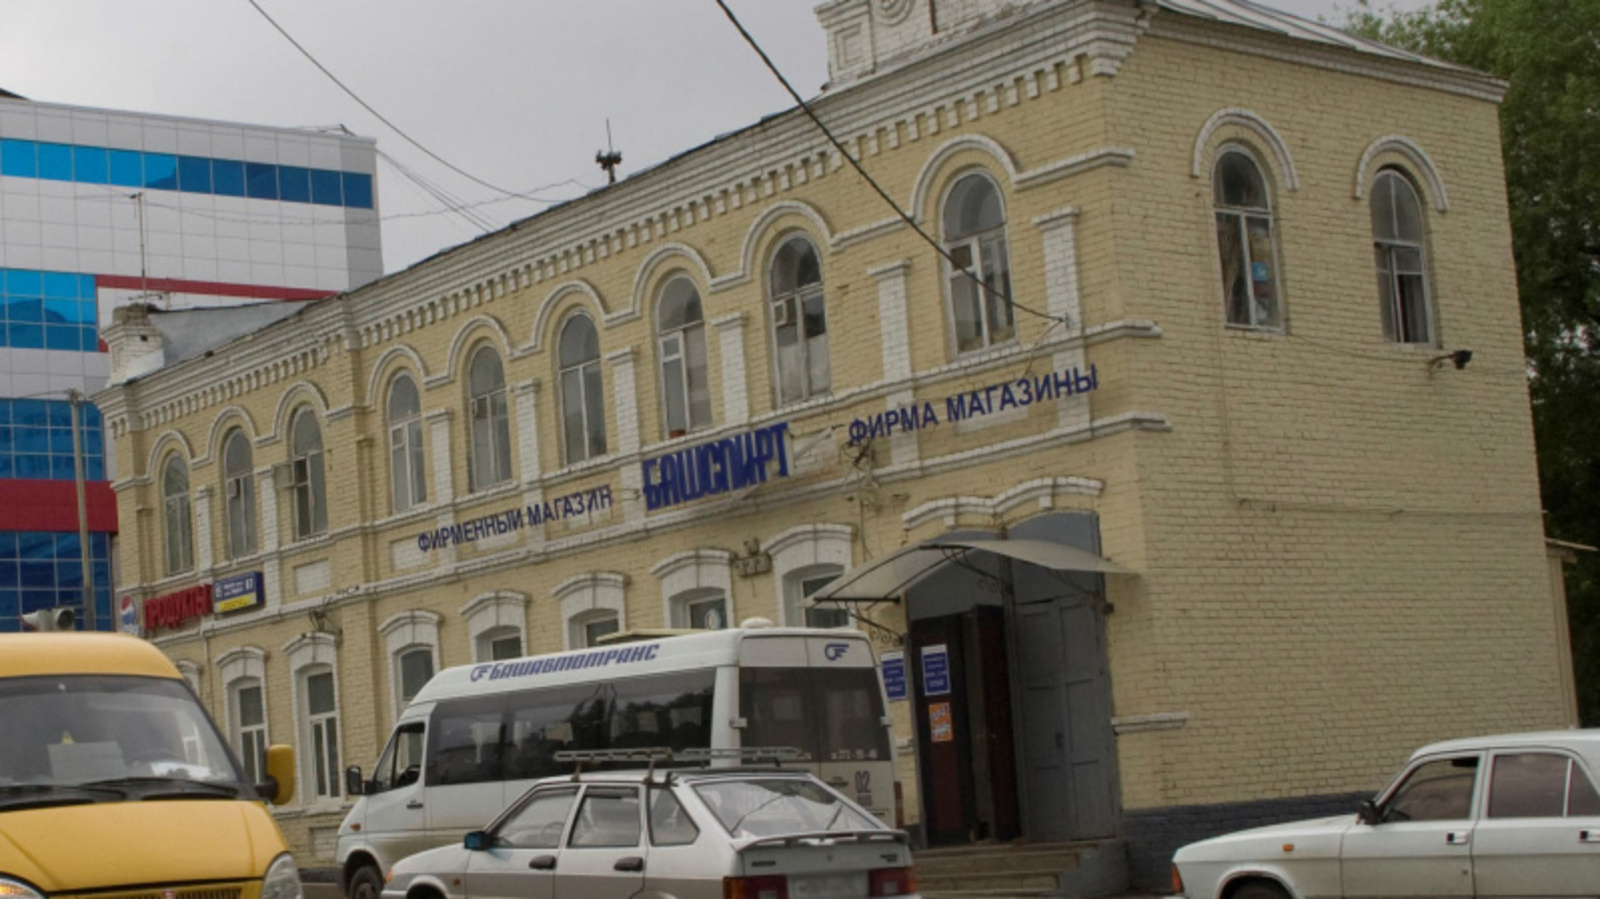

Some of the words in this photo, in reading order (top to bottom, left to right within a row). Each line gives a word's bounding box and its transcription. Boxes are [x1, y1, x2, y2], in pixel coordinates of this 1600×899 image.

[848, 402, 938, 443] ФИРМА
[946, 364, 1097, 422] МАГАЗИНЫ
[642, 422, 790, 511] БАШСПИРТ
[417, 506, 525, 553] ФИРМЕННЫЙ
[526, 485, 613, 527] МАГАЗИН
[145, 585, 213, 629] ПРОДУКТЫ
[855, 770, 871, 793] 02
